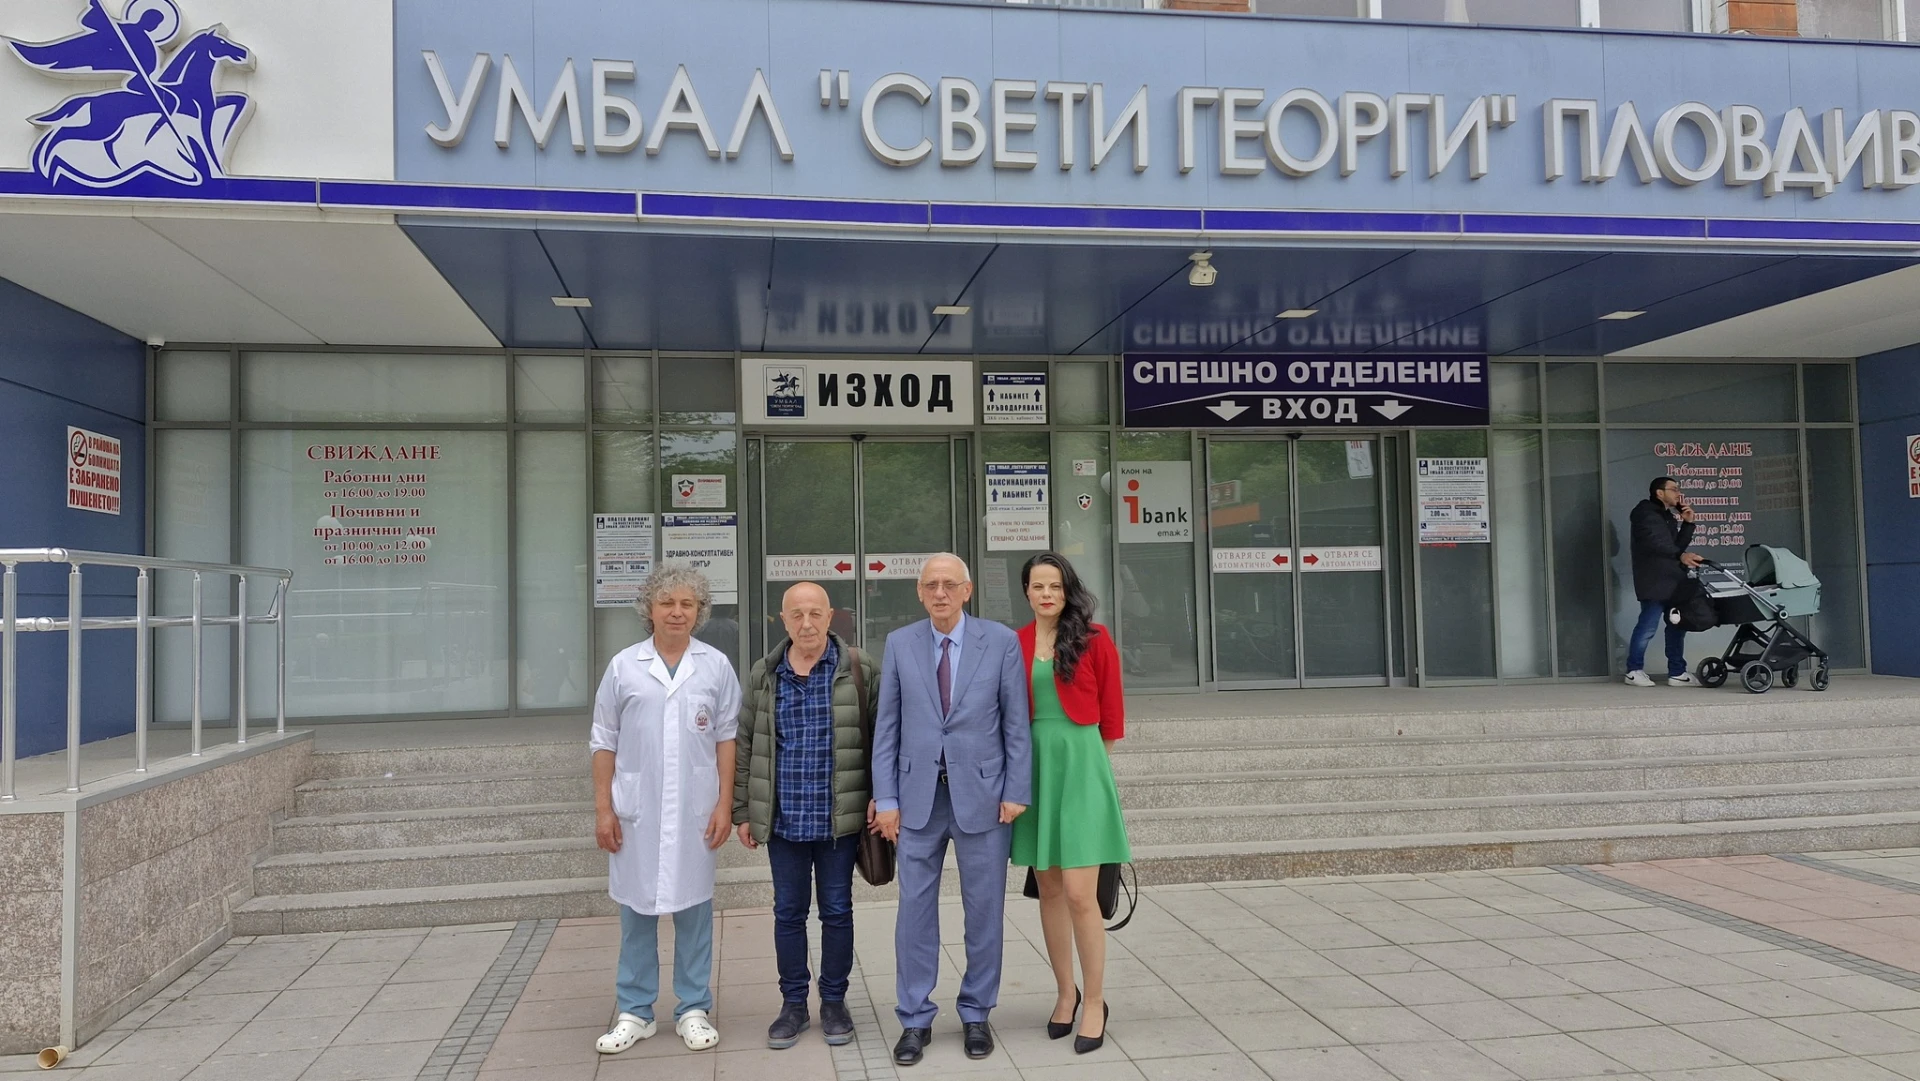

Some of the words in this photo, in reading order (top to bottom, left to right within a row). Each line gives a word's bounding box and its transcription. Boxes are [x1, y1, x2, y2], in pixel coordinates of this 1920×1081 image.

[421, 48, 795, 162] УМБАЛ
[819, 69, 1150, 174] "СВЕТИ
[1177, 86, 1516, 180] ГЕОРГИ"
[1543, 97, 1920, 198] ПЛОВДИВ
[1132, 360, 1278, 384] СПЕШНО
[1287, 360, 1482, 388] ОТДЕЛЕНИЕ
[817, 372, 953, 413] ИЗХОД
[986, 404, 1043, 412] КРЪВОДАРЯВАНЕ
[1262, 397, 1358, 423] ВХОД
[88, 436, 92, 449] В
[112, 443, 120, 456] НА
[307, 444, 441, 462] СВИЖДАНЕ
[88, 453, 120, 472] БОЛНИЦАТА
[1666, 463, 1717, 476] Работни
[1719, 467, 1742, 477] дни
[1910, 466, 1916, 480] Е
[69, 467, 74, 484] Е
[75, 468, 120, 492] ЗАБРАНЕНО
[323, 469, 392, 484] Работни
[396, 473, 426, 485] дни
[988, 478, 1046, 487] ВАКСИНАЦИОНЕН
[1679, 479, 1705, 489] 16.00
[324, 490, 338, 498] от
[341, 488, 374, 498] 16.00
[376, 490, 391, 499] до
[394, 487, 426, 498] 19.00
[1002, 490, 1032, 498] КАБИНЕТ
[69, 488, 120, 512] ПУШЕНЕТО!!!
[1730, 496, 1739, 505] и
[330, 504, 406, 518] Почивни
[410, 507, 420, 517] и
[313, 526, 403, 541] празнични
[406, 525, 437, 537] дни
[341, 541, 374, 551] 10.00
[376, 544, 391, 552] до
[394, 540, 426, 551] 12.00
[324, 557, 338, 565] от
[341, 555, 374, 565] 16.00
[376, 557, 391, 566] до
[394, 553, 426, 564] 19.00
[665, 549, 734, 558] ЗДРАВНО-КОНСУЛТАТИВЕН
[1216, 552, 1252, 560] ОТВАРЯ
[1254, 551, 1267, 559] СЕ
[1323, 551, 1359, 559] ОТВАРЯ
[1361, 550, 1373, 558] СЕ
[773, 559, 813, 567] ОТВАРЯ
[815, 559, 828, 567] СЕ
[1212, 561, 1272, 569] АВТОМАТИЧНО
[1320, 560, 1378, 568] АВТОМАТИЧНО
[769, 569, 833, 577] АВТОМАТИЧНО
[888, 568, 921, 576] АВТОМА
